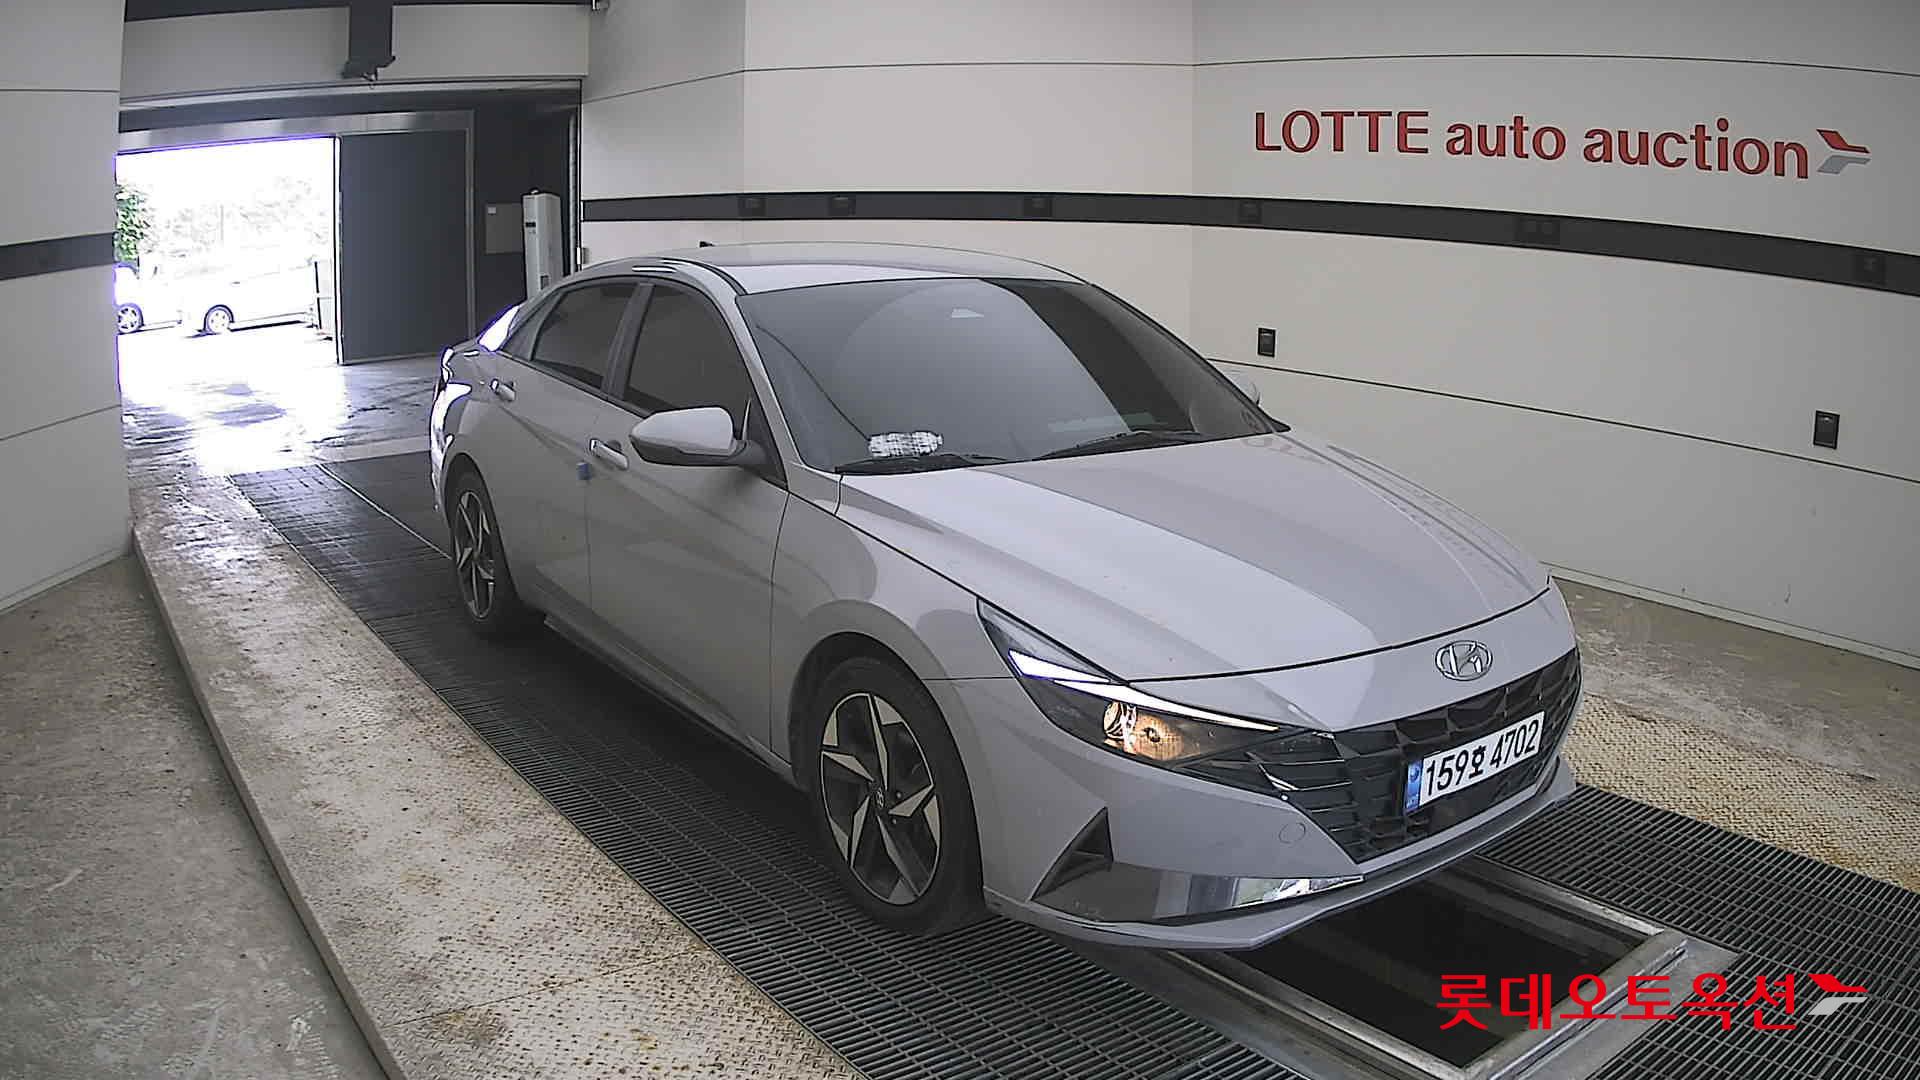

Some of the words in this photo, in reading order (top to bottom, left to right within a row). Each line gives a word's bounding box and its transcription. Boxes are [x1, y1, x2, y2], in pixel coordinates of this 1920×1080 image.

[1255, 110, 1429, 154] LOTTE
[1446, 115, 1567, 160] auto
[1583, 117, 1809, 179] auction
[1426, 745, 1487, 796] 159호
[1490, 719, 1539, 769] 4702
